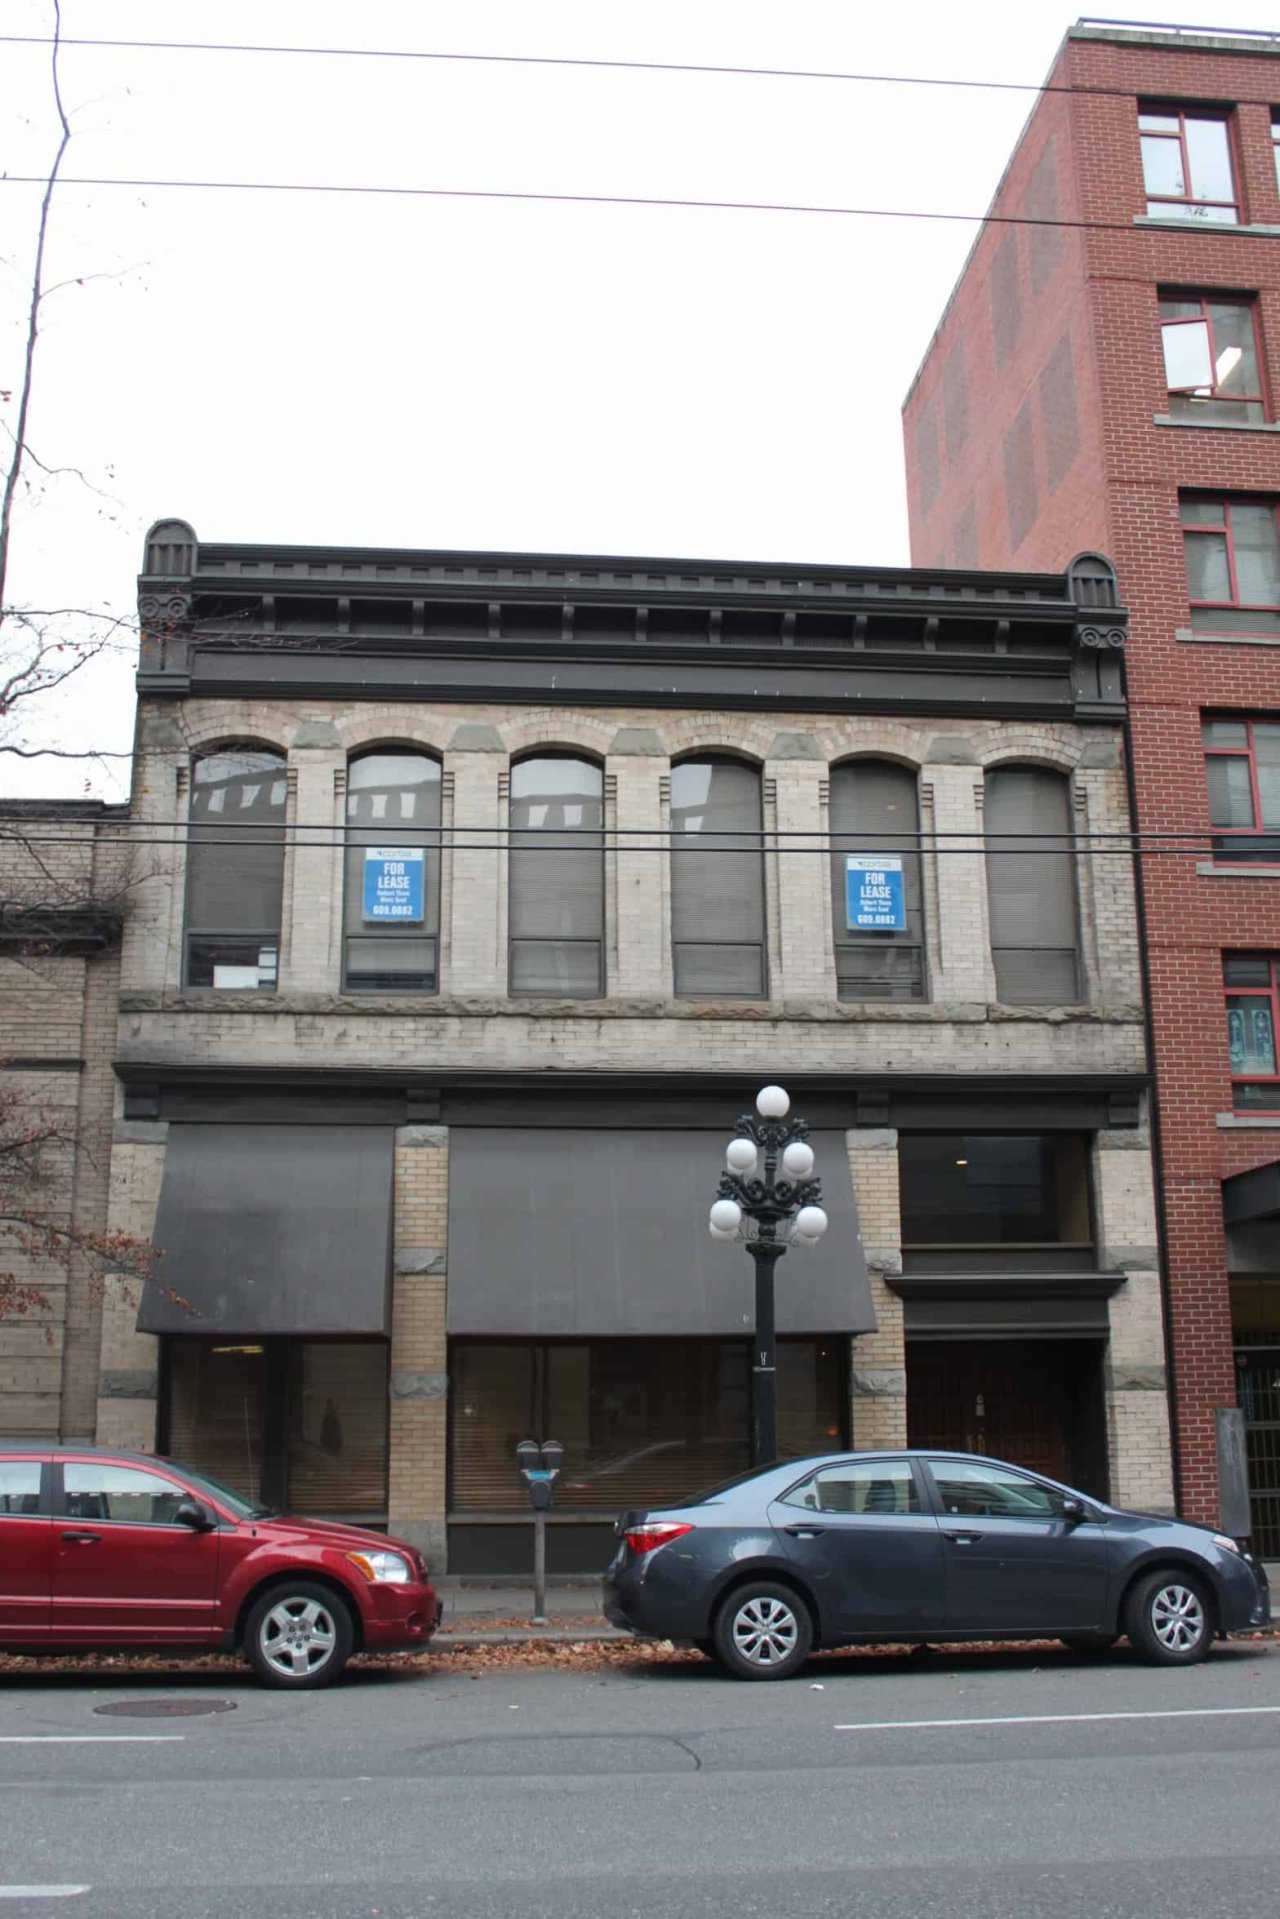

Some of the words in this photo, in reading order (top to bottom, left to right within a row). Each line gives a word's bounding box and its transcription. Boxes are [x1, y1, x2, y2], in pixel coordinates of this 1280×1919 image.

[384, 862, 405, 875] FOR
[378, 876, 410, 889] LEASE
[865, 872, 886, 885] FOR
[860, 886, 892, 899] LEASE
